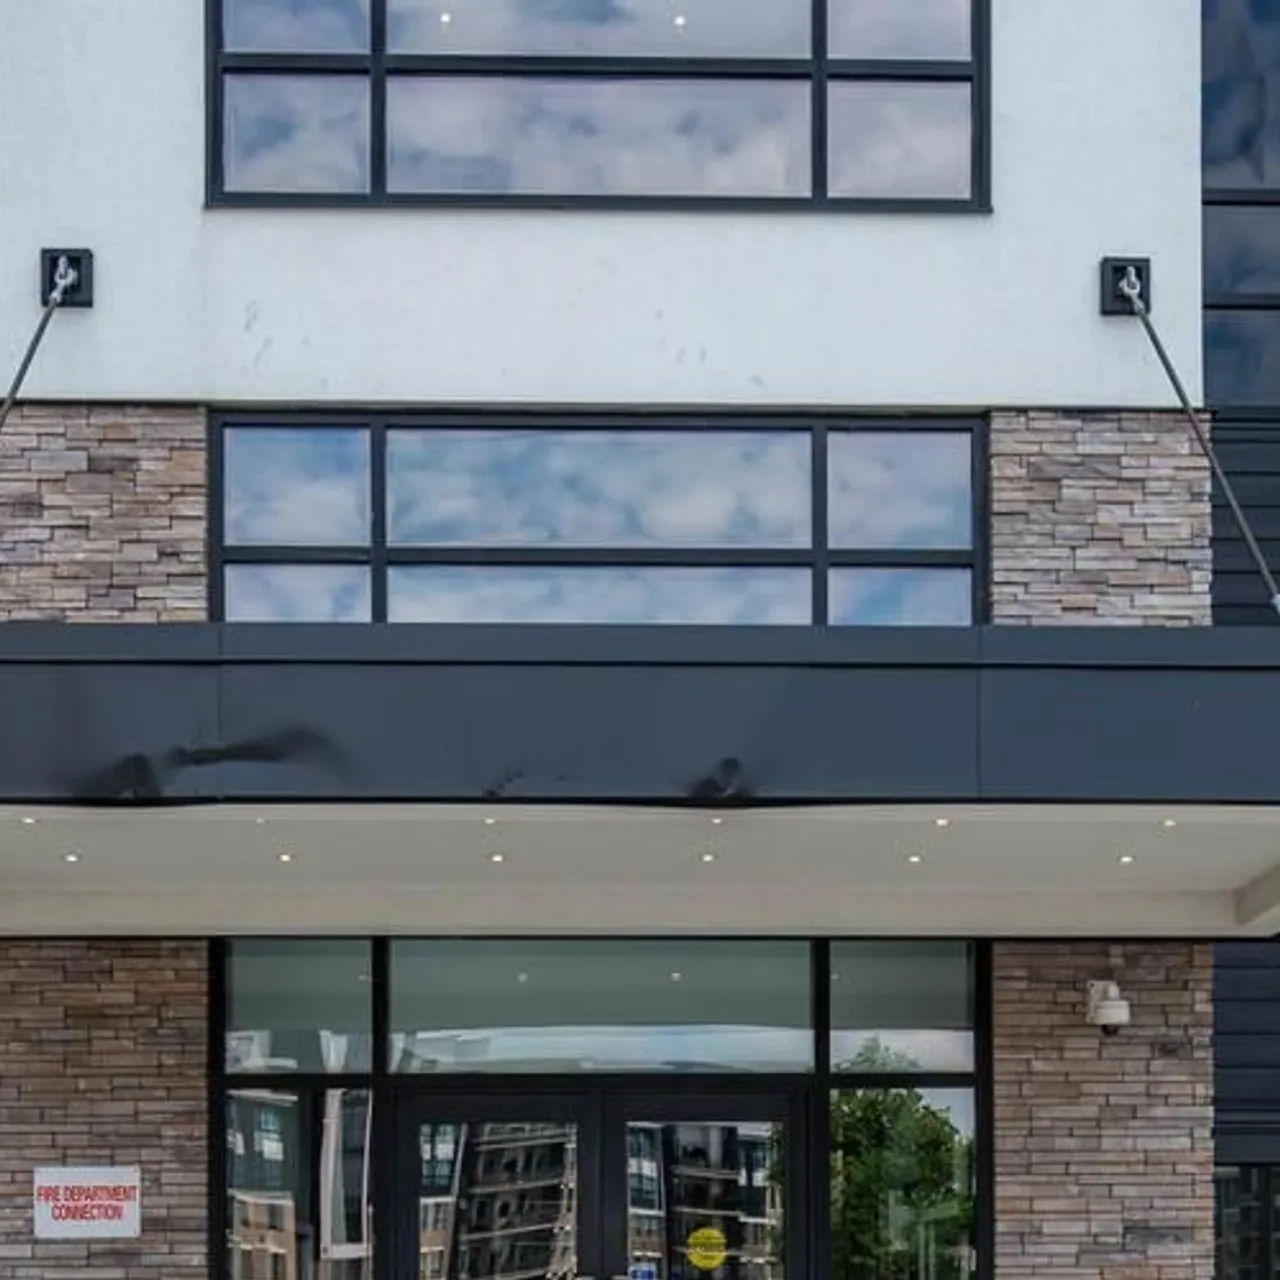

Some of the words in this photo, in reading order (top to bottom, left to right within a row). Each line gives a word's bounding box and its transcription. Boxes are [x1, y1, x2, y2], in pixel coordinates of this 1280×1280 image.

[37, 1185, 60, 1202] FIRE
[63, 1185, 137, 1202] DEPARTMENT
[51, 1204, 124, 1220] CONNECTION
